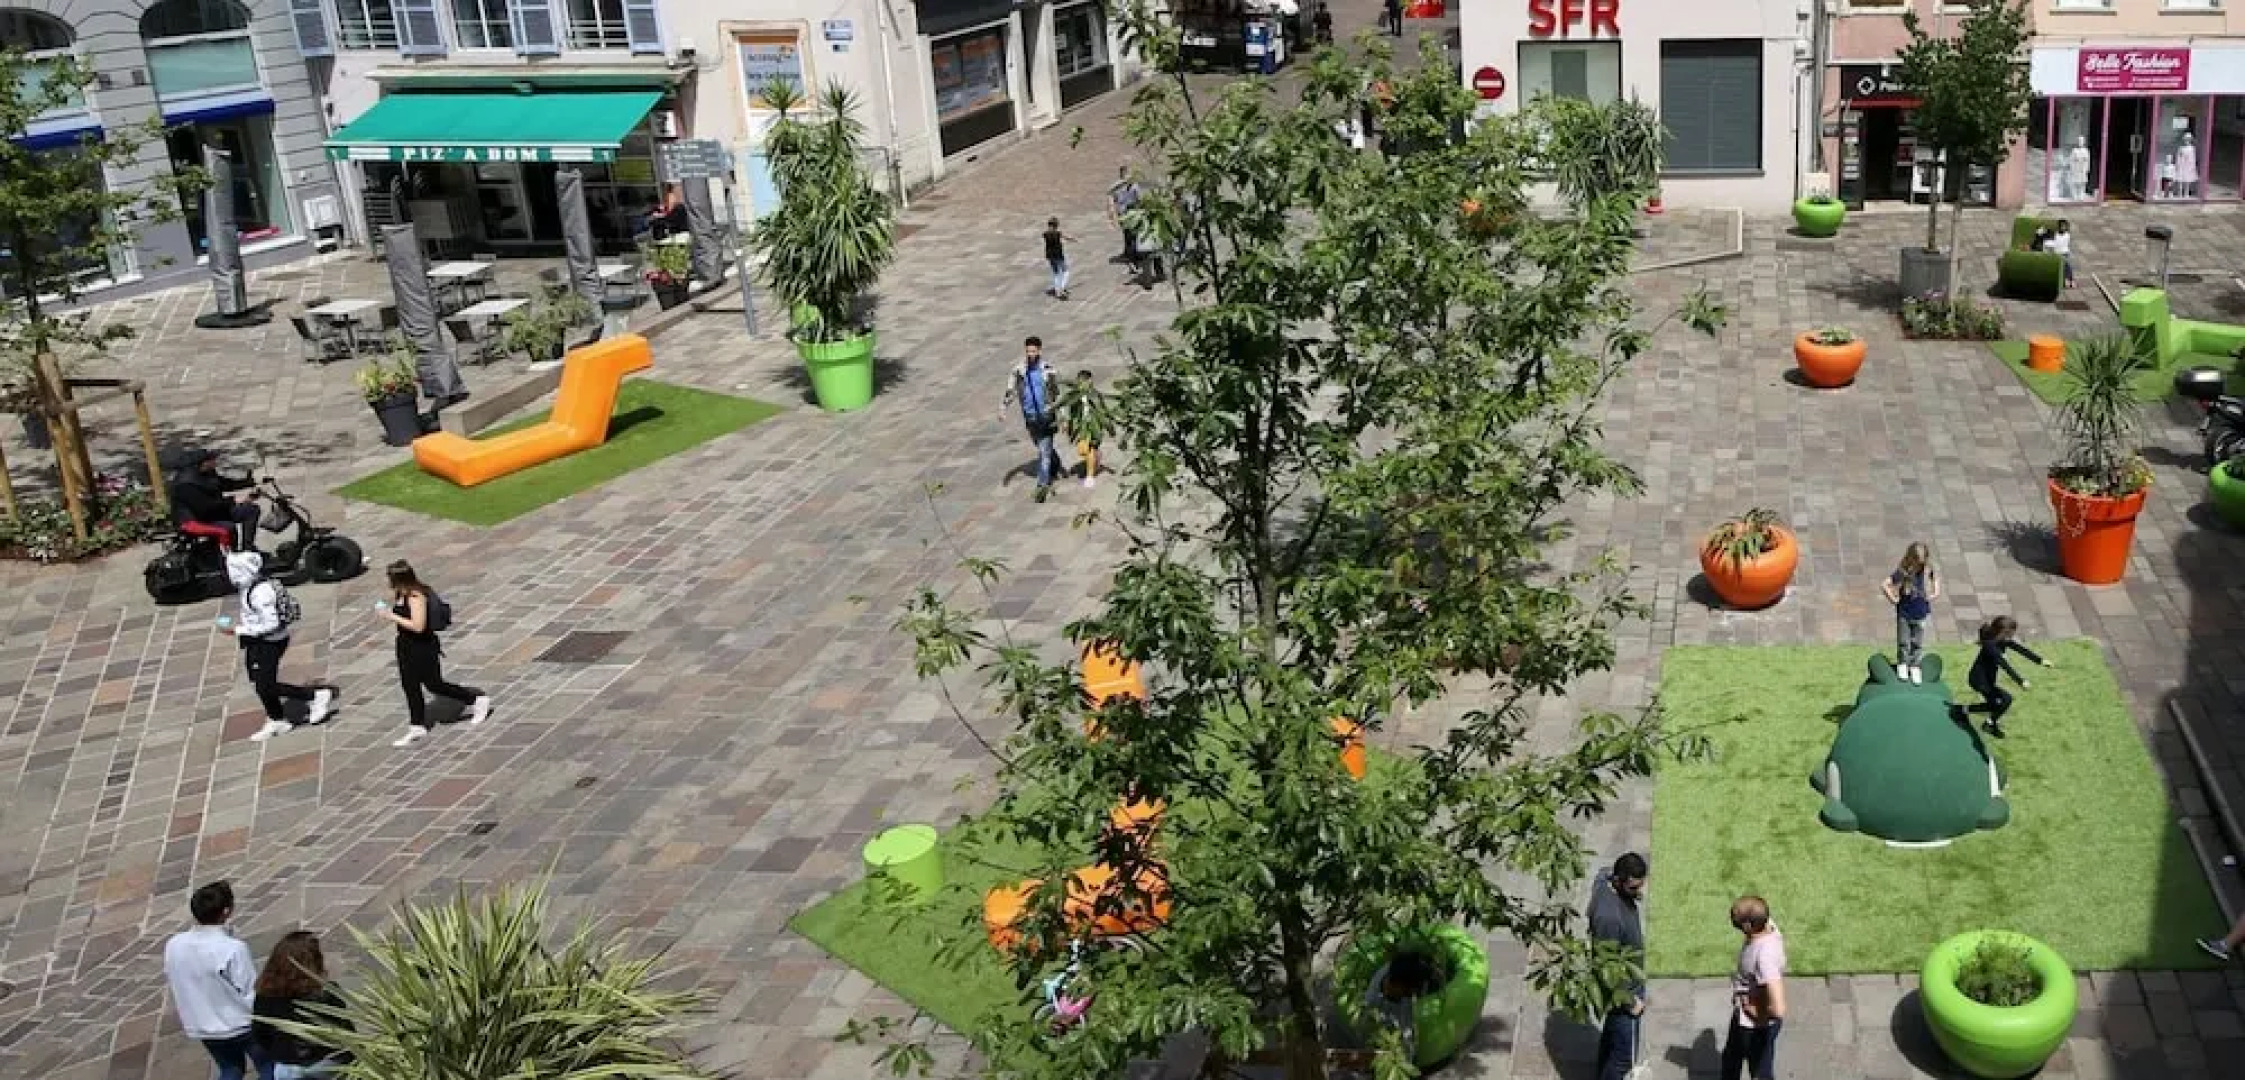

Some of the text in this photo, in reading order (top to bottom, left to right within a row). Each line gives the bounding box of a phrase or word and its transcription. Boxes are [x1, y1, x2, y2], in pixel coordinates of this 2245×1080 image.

[1528, 0, 1620, 38] SFR
[2085, 53, 2181, 71] Belle Fashion
[464, 147, 477, 161] A
[487, 147, 539, 161] DOM
